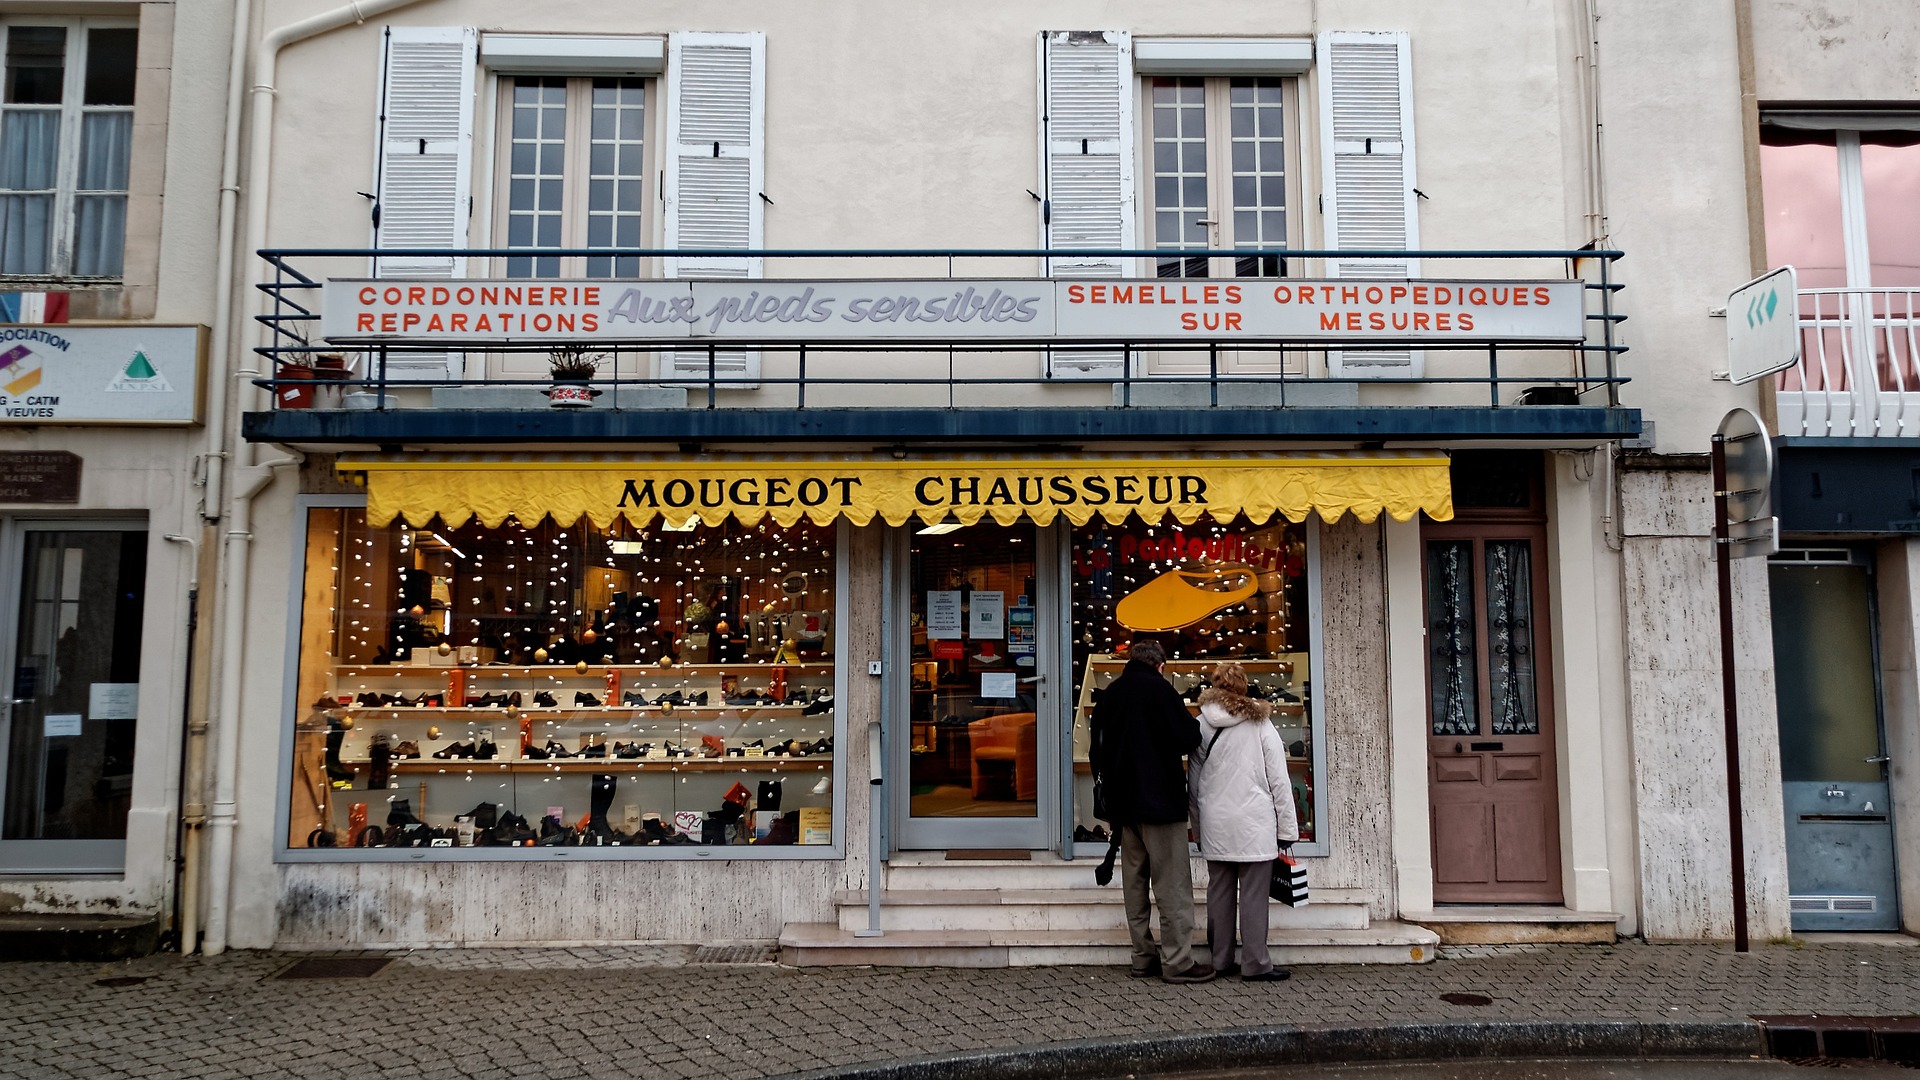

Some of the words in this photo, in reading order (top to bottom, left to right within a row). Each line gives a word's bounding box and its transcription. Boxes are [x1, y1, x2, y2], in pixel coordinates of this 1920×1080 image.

[358, 286, 601, 306] CORDONNERIE
[1067, 284, 1243, 305] SEMELLES
[1273, 285, 1552, 307] ORTHOPEDIQUES
[607, 287, 700, 325] Aux
[705, 286, 836, 334] pieds
[840, 286, 1041, 323] sensibles
[356, 312, 600, 333] REPARATIONS
[1180, 312, 1243, 332] SUR
[1319, 312, 1476, 332] MESURES
[26, 396, 60, 406] CATM
[6, 407, 55, 418] VEUVES
[617, 477, 862, 508] MOUGEOT
[914, 475, 1210, 506] CHAUSSEUR
